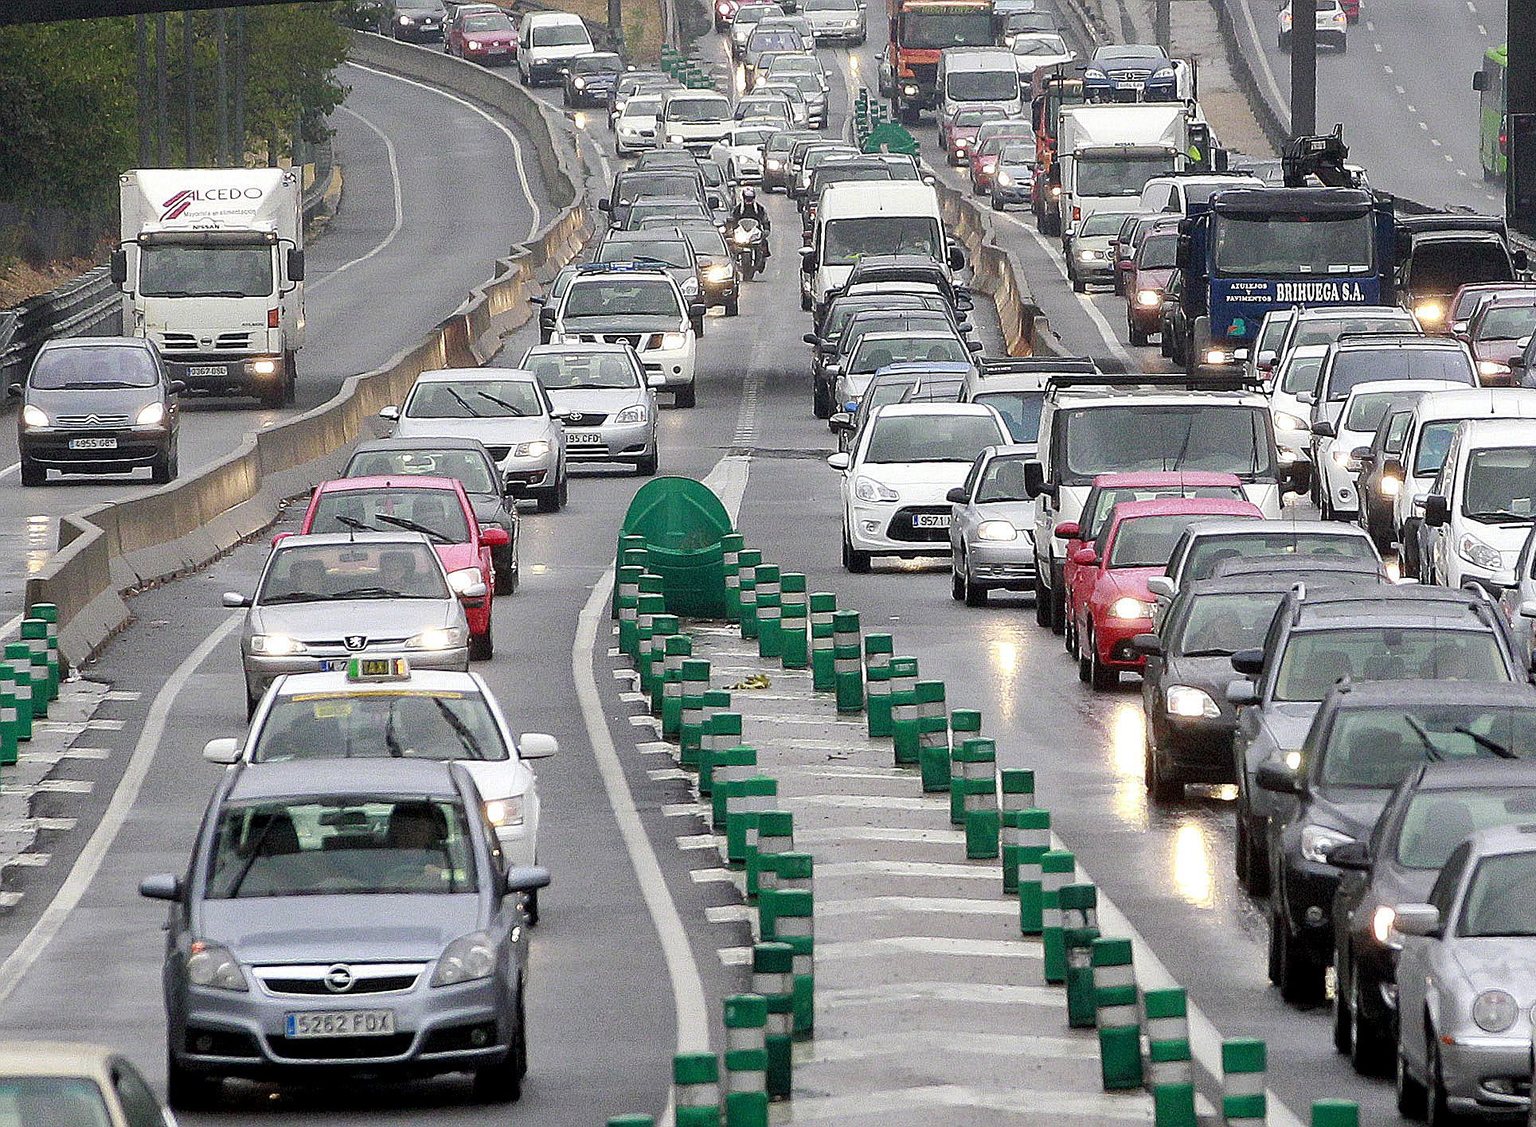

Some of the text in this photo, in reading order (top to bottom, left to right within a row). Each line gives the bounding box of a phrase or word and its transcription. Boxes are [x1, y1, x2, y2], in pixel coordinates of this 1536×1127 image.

[1276, 283, 1365, 302] BRIHUEGA S.A.
[565, 434, 599, 443] 195 CFD
[920, 516, 944, 526] 9571
[299, 1013, 391, 1034] 5262 FDX
